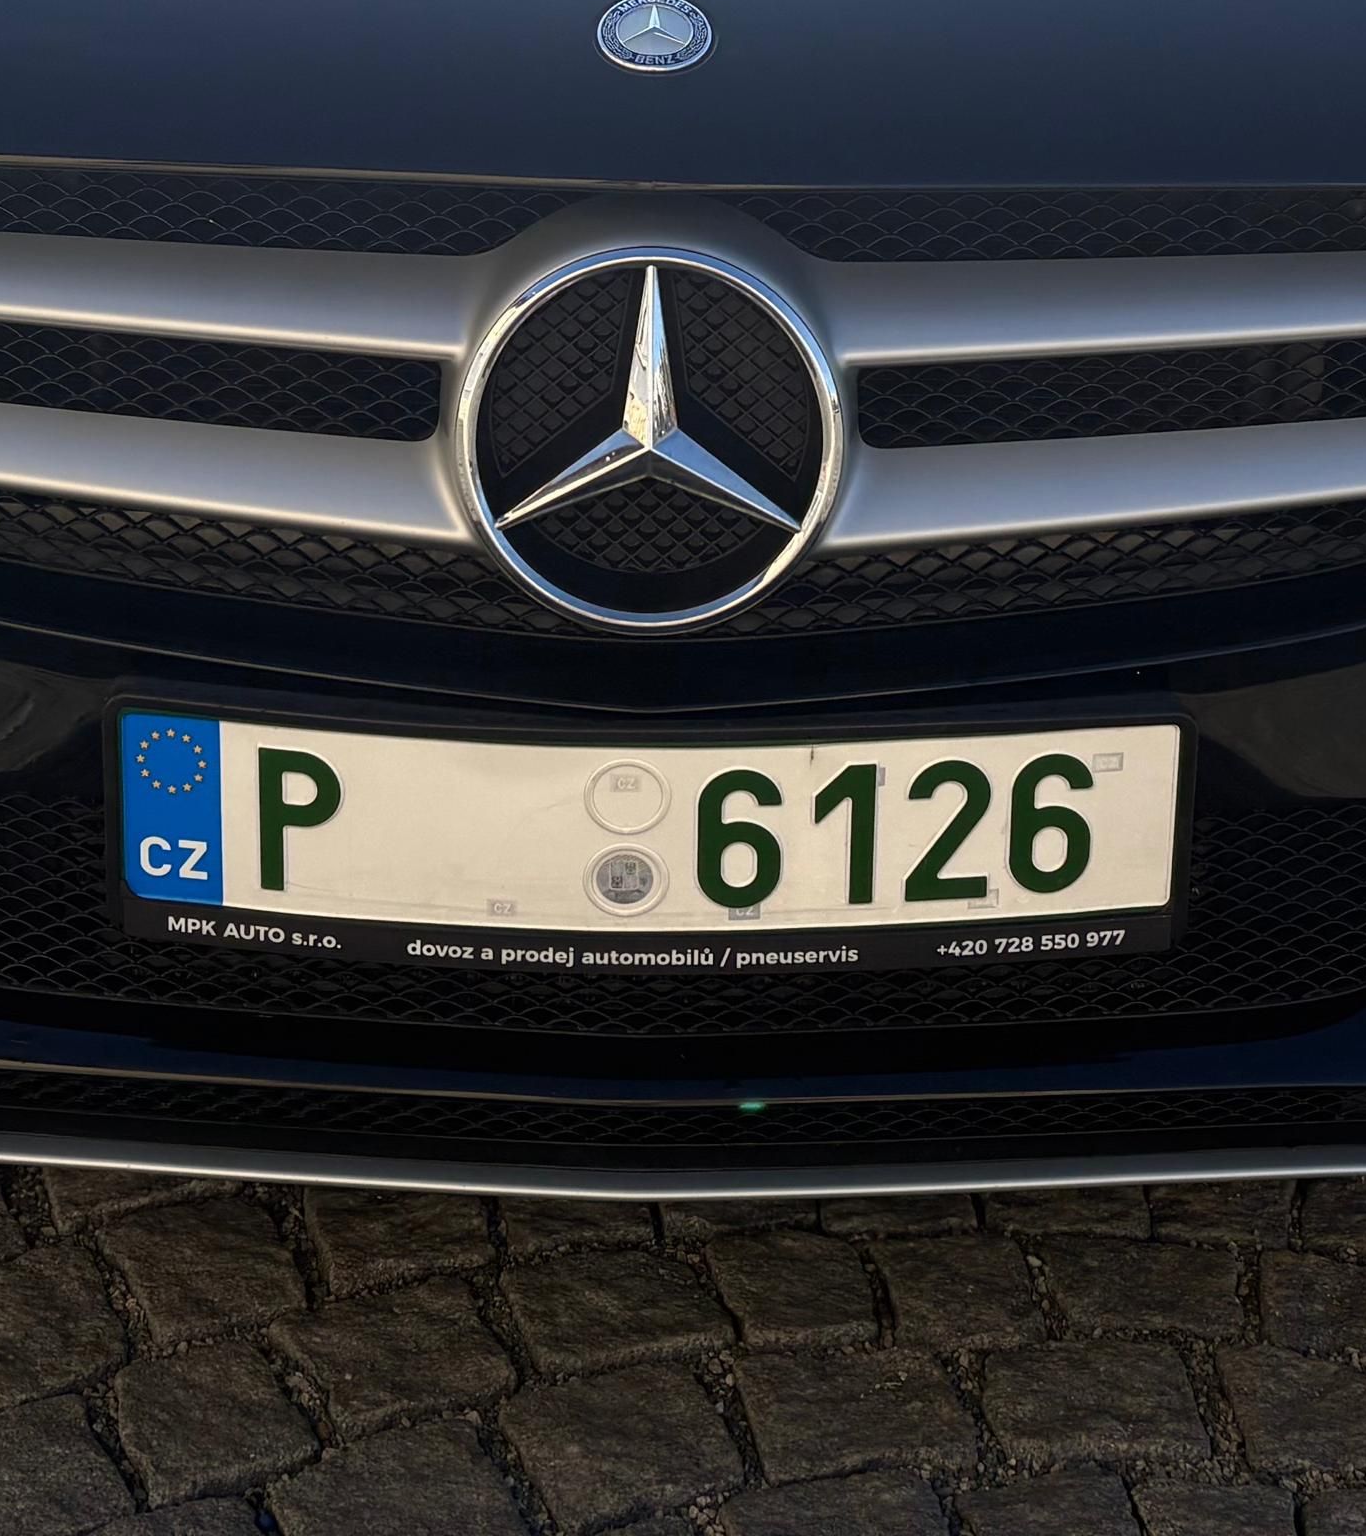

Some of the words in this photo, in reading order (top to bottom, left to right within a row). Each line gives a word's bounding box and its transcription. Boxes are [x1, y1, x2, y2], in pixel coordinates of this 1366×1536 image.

[635, 54, 676, 65] BENZ
[258, 747, 342, 891] P
[696, 752, 1094, 908] 6126
[139, 836, 209, 881] CZ
[167, 916, 217, 937] MPK
[223, 923, 285, 944] AUTO
[291, 932, 342, 950] s.r.o.
[936, 939, 988, 957] +420
[994, 936, 1034, 954] 728
[1040, 933, 1080, 951] 550
[1086, 929, 1125, 948] 977
[406, 939, 475, 960] dovoz
[480, 947, 494, 961] a
[501, 947, 575, 967] prodej
[581, 948, 714, 966] automobilů
[720, 947, 731, 968] /
[736, 945, 859, 969] pneuservis
